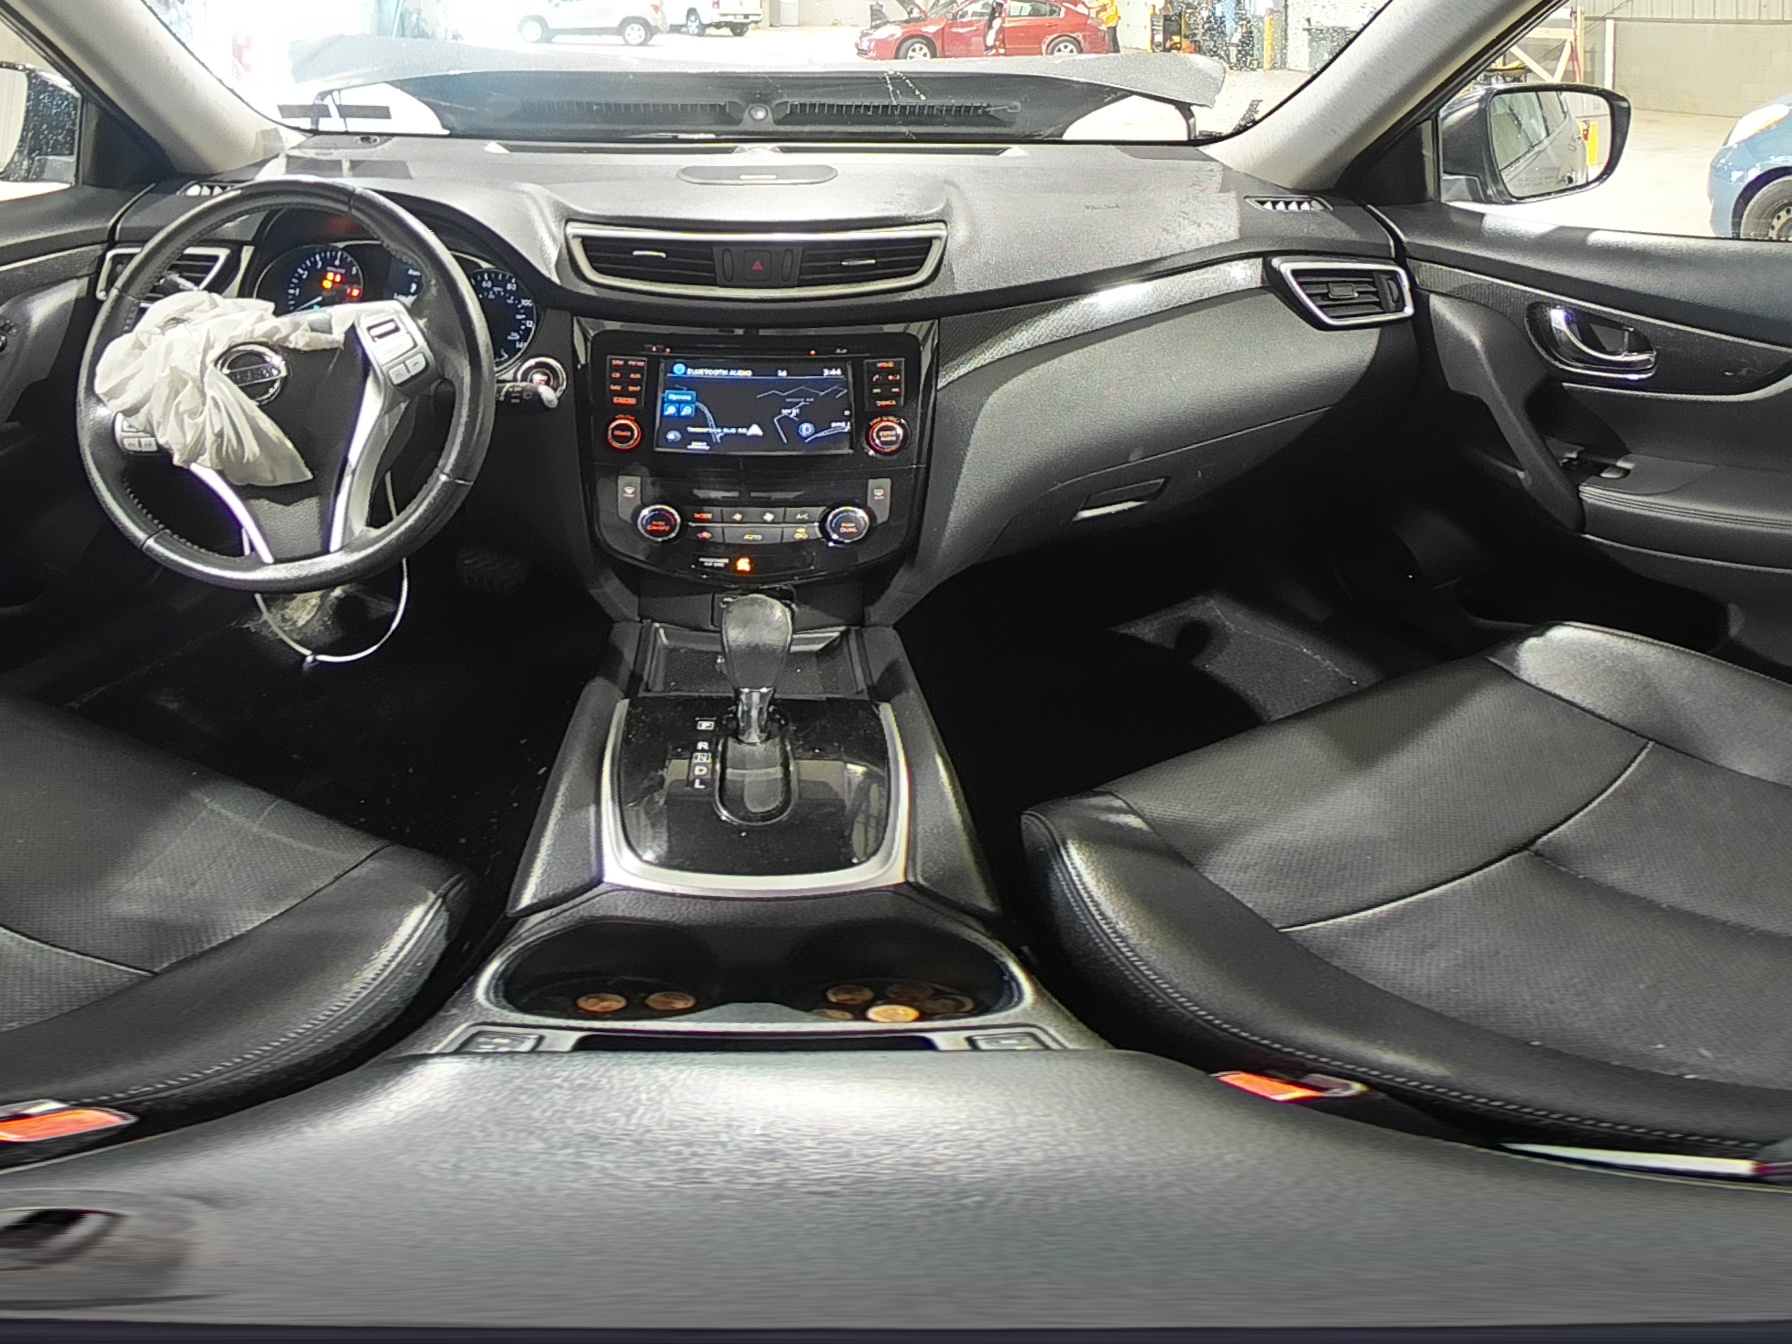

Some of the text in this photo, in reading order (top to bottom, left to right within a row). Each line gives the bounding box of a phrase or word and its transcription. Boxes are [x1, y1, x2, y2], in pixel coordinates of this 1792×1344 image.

[696, 740, 709, 751] R
[694, 765, 708, 776] D
[694, 778, 707, 789] L
